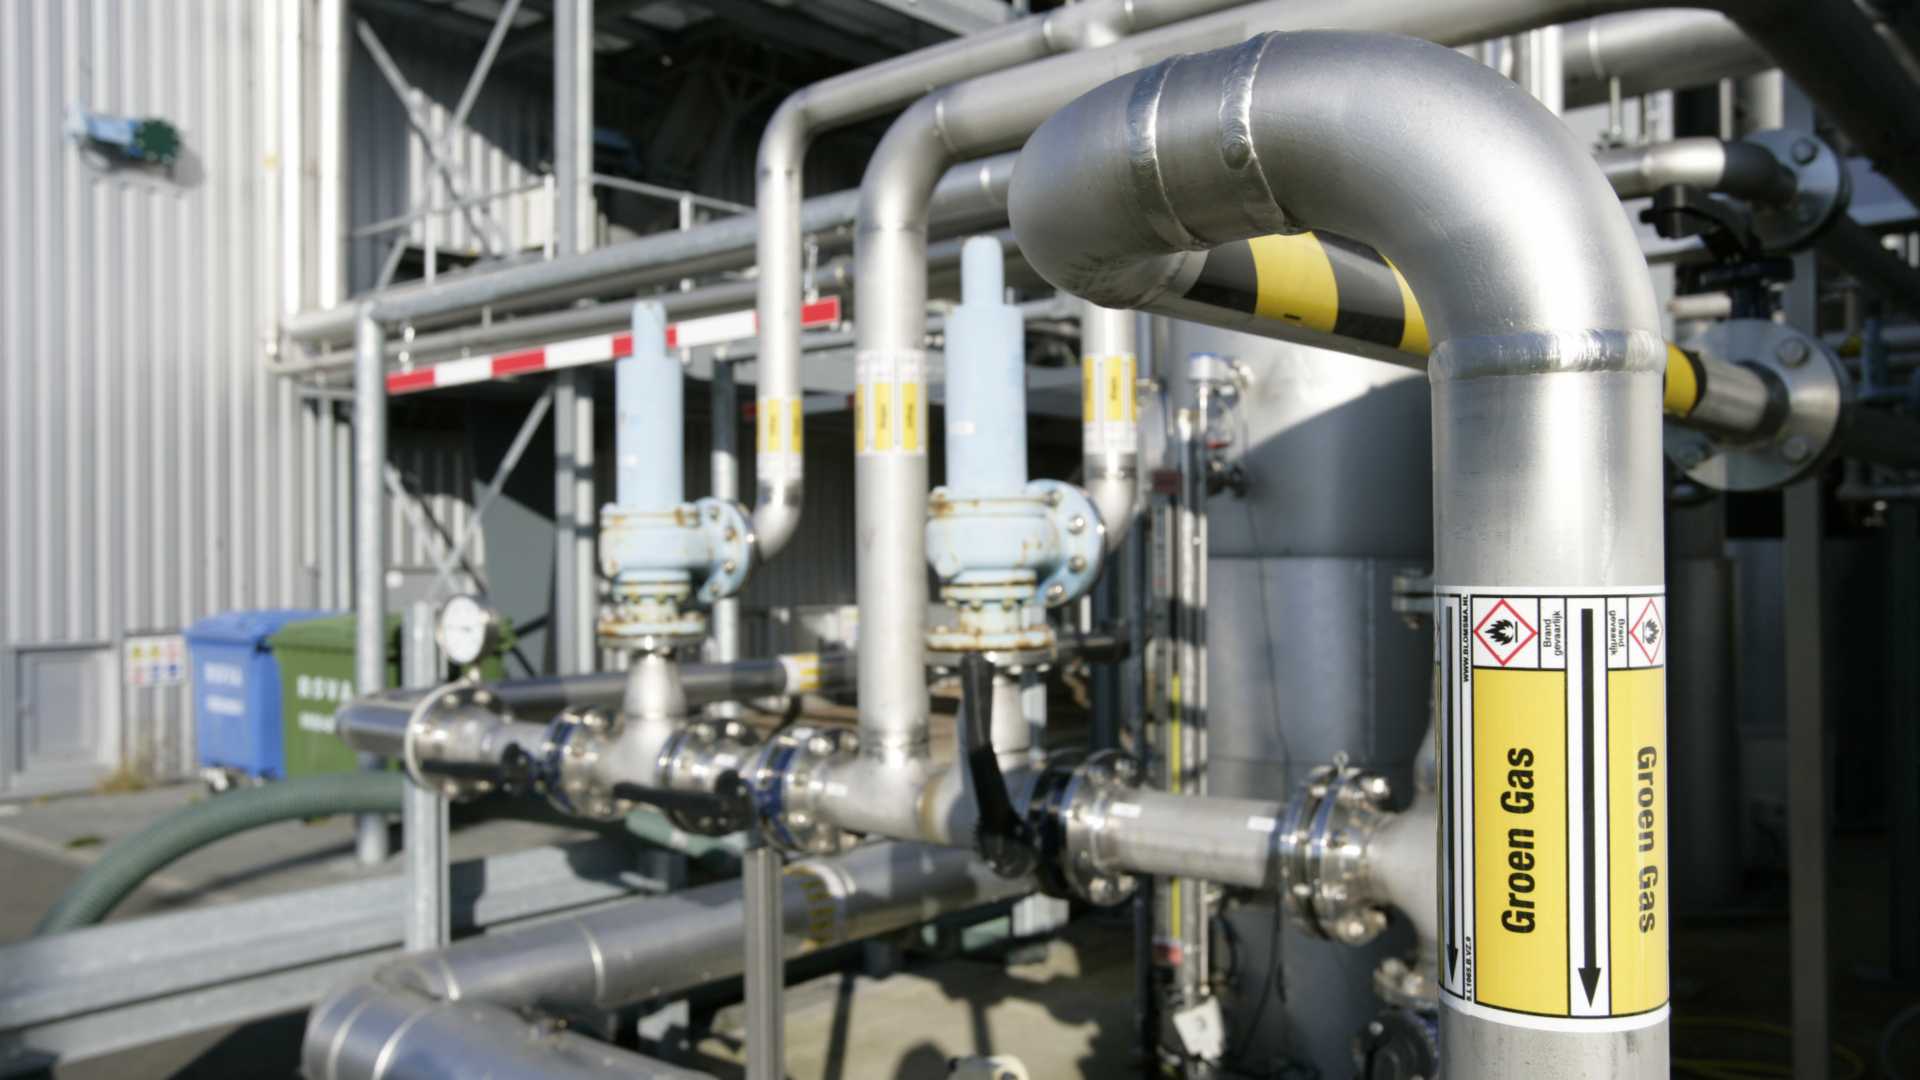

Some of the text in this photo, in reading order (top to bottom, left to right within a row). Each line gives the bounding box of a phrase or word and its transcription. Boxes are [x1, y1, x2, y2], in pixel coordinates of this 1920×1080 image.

[1543, 619, 1552, 648] Brand
[1554, 610, 1563, 656] gevaarlijk
[1501, 748, 1535, 933] Groen Gas
[1638, 747, 1657, 933] Groen Gas
